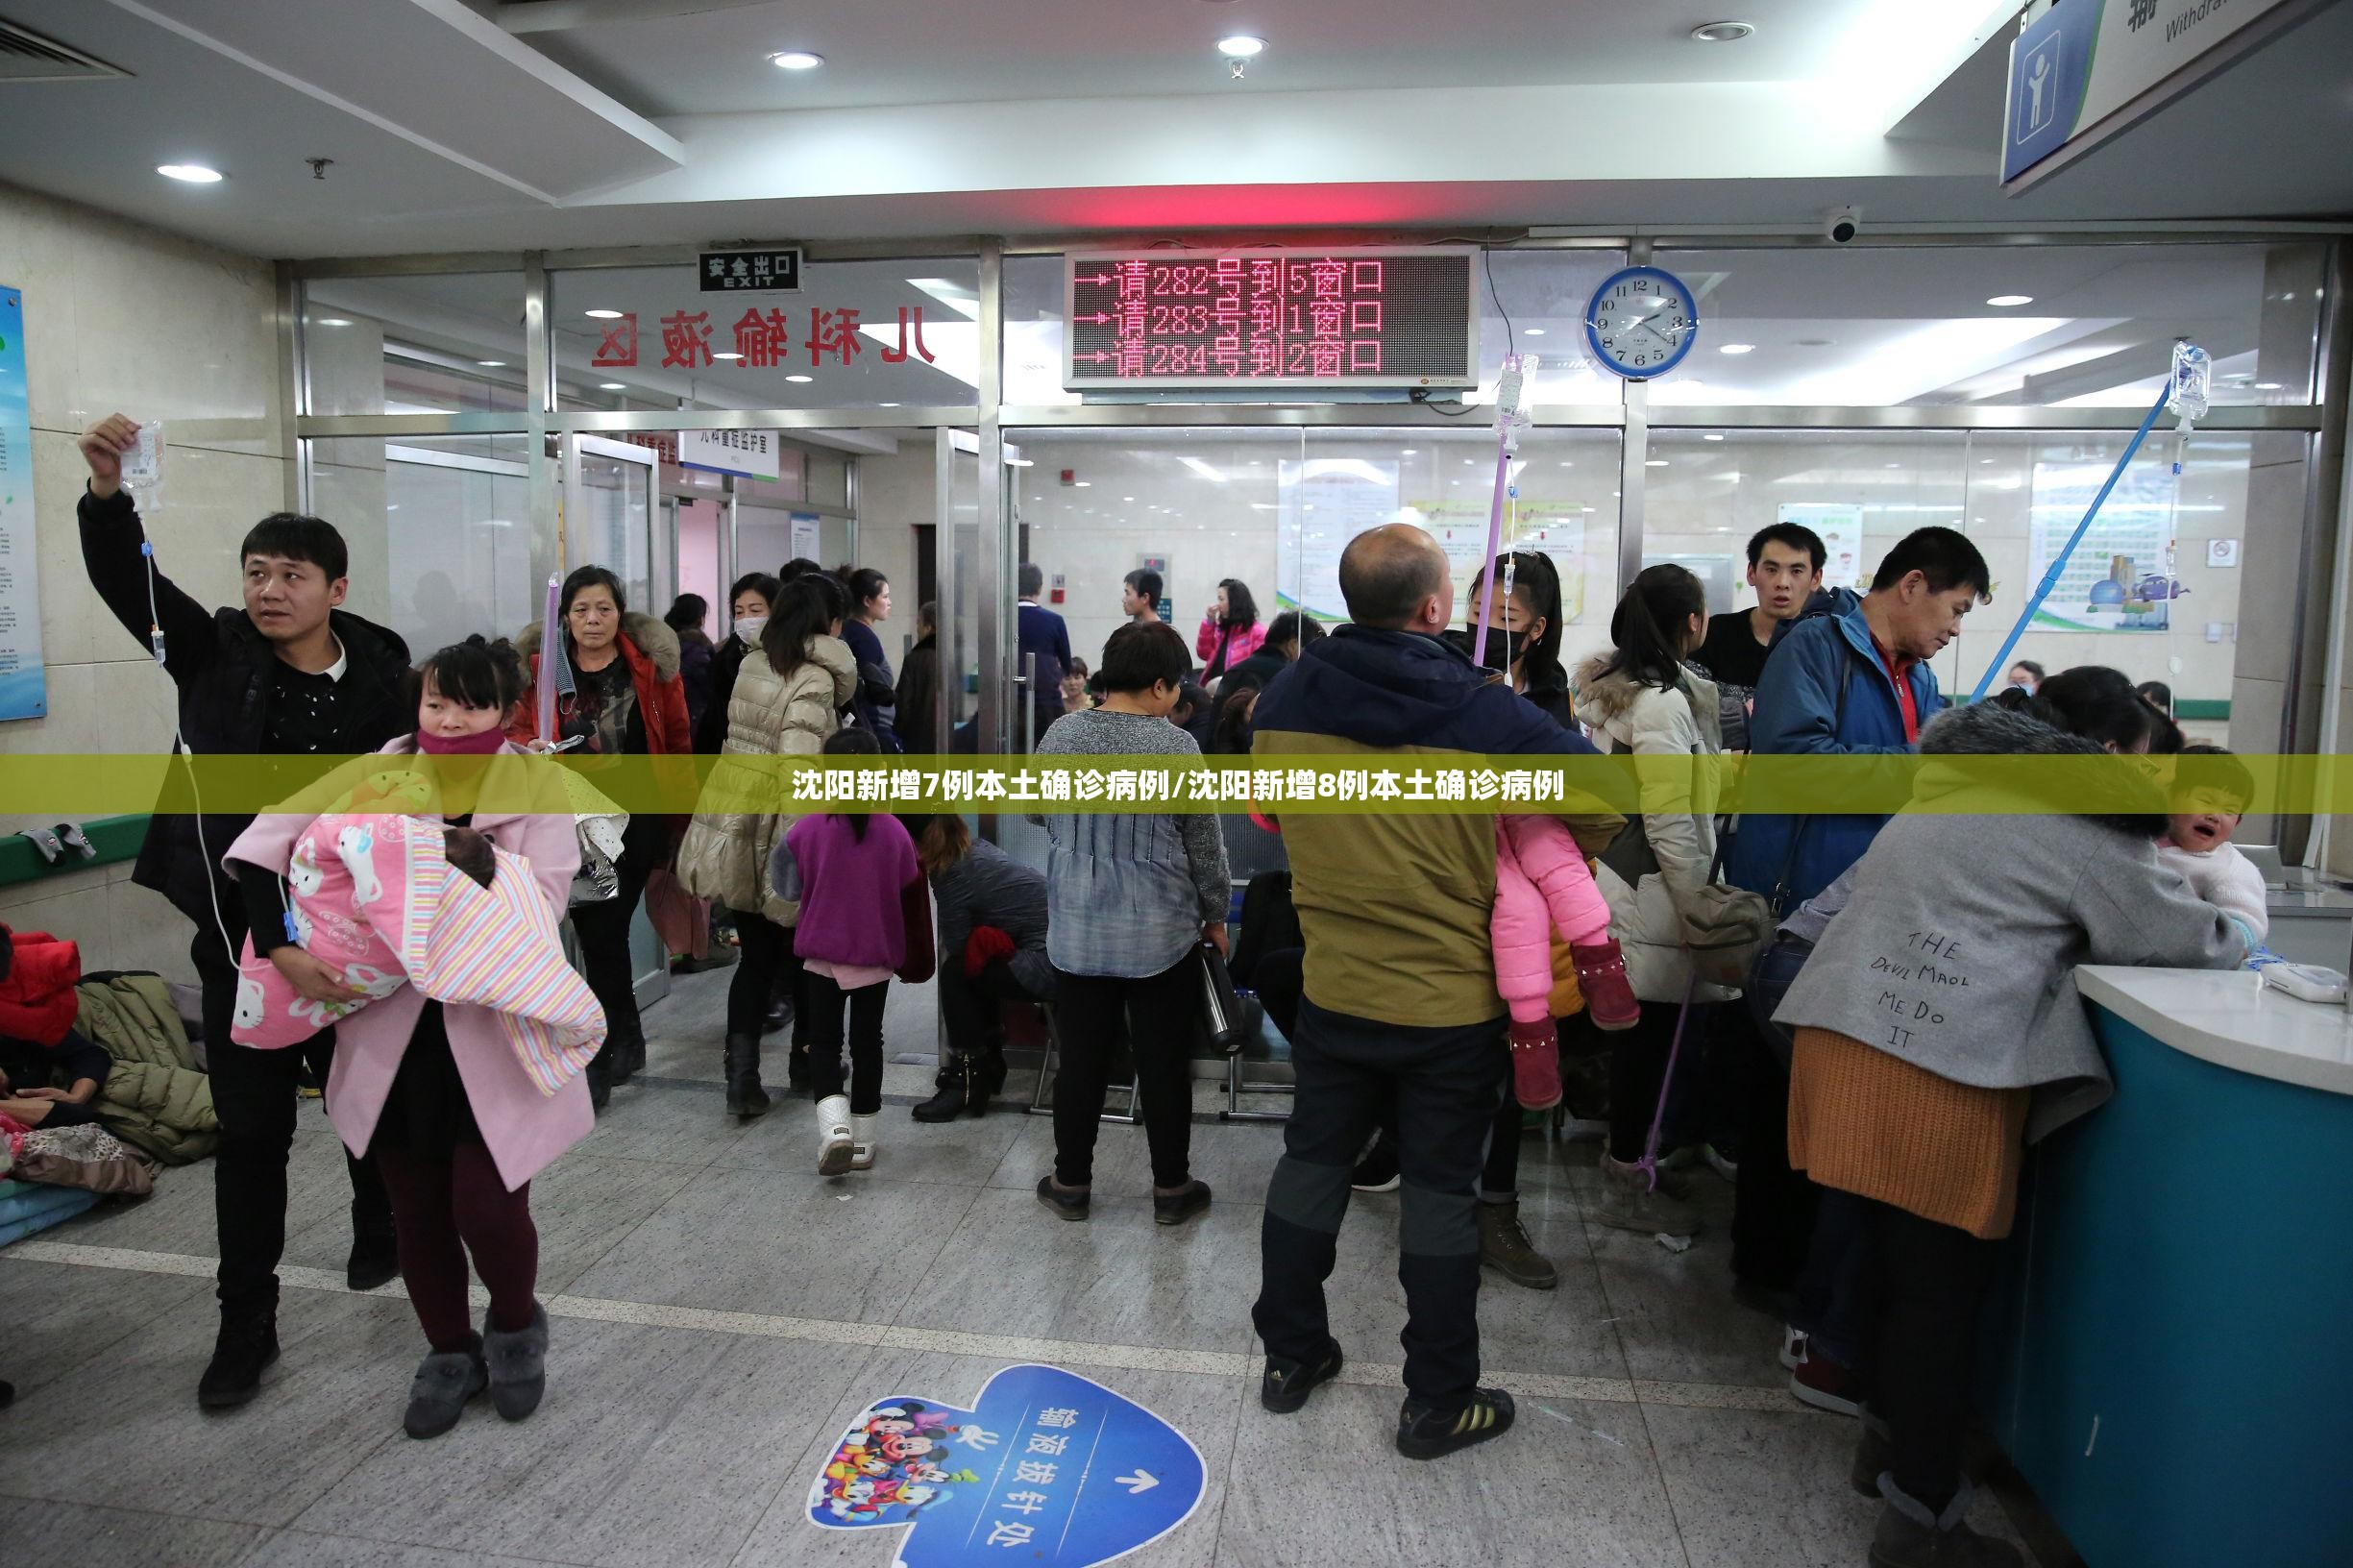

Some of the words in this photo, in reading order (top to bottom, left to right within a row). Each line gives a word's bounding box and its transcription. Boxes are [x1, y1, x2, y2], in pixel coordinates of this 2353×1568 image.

[709, 255, 790, 278] 安全出口
[723, 276, 774, 288] EXIT
[1113, 257, 1384, 300] 请282号到5窗口
[1616, 285, 1627, 297] 11
[1633, 280, 1648, 292] 12
[1656, 284, 1661, 296] 1
[1602, 299, 1615, 311] 10
[1667, 297, 1678, 309] 2
[1113, 297, 1383, 339] 请283号到1窗口
[1597, 318, 1608, 331] 9
[1672, 316, 1682, 328] 3
[1603, 336, 1612, 349] 8
[1666, 334, 1678, 347] 4
[1112, 335, 1382, 378] 请284号到2窗口
[1615, 350, 1627, 362] 7
[1634, 354, 1646, 366] 6
[1654, 349, 1664, 361] 5
[1908, 932, 1961, 959] THE
[1871, 956, 1910, 980] DEVIL
[1877, 991, 1906, 1015] ME
[1886, 1025, 1914, 1048] IT
[986, 1407, 1080, 1548] 输液拔针处
